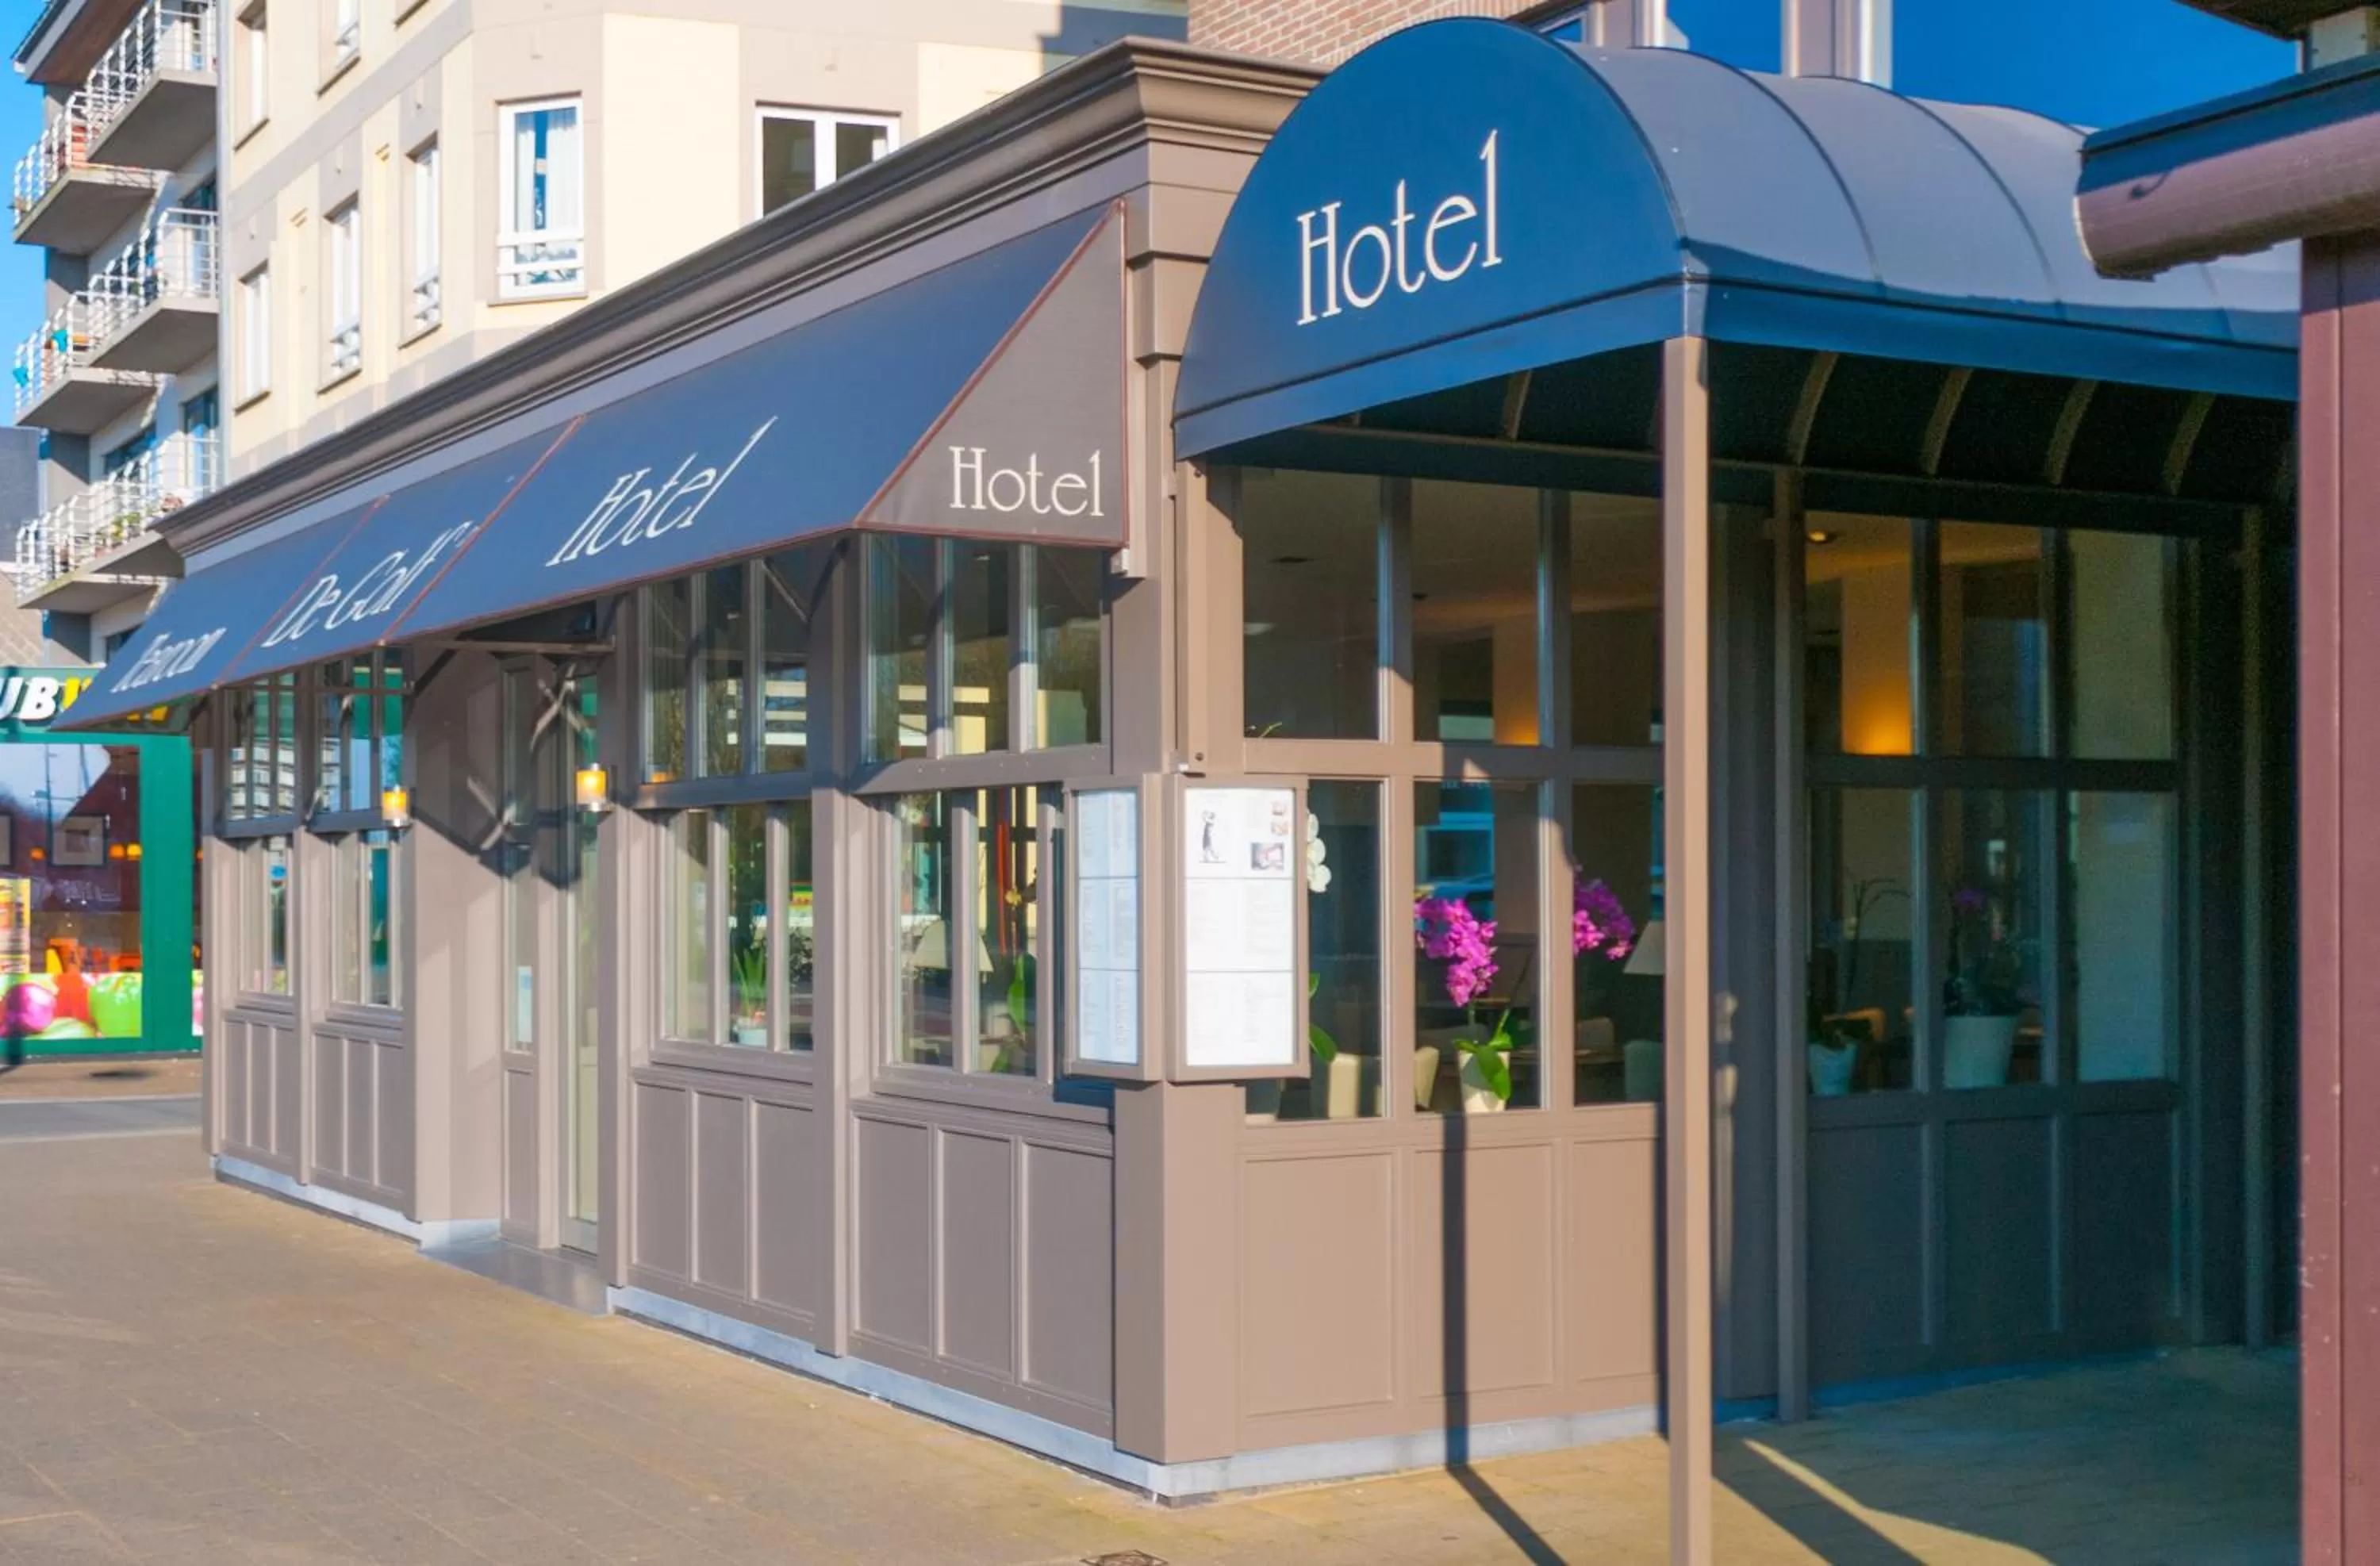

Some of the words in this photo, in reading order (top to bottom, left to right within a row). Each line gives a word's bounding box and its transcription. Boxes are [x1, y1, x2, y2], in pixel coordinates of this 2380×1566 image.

[1296, 129, 1503, 326] Hotel
[546, 415, 778, 567] Hotel
[949, 446, 1105, 517] Hotel
